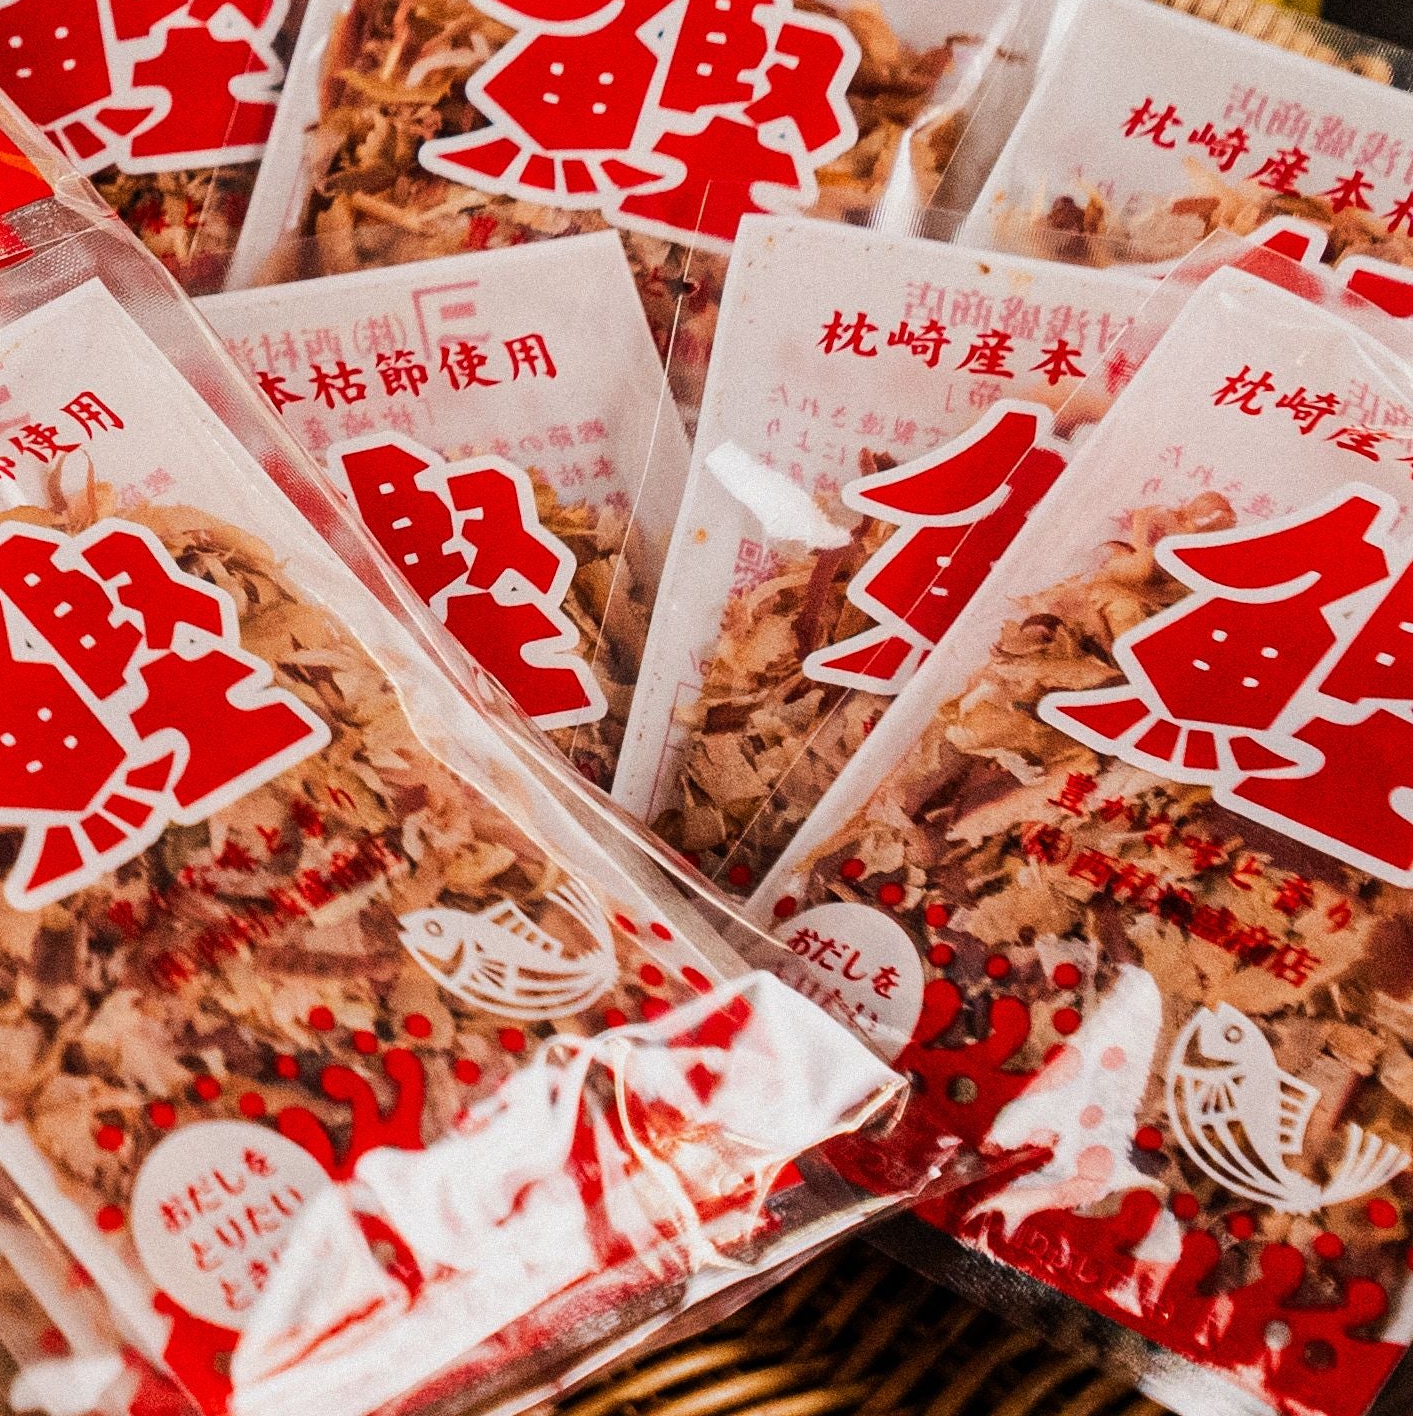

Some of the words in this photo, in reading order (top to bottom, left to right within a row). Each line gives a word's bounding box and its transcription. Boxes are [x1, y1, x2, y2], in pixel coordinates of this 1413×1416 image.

[817, 309, 1139, 396] 枕崎産本
[1211, 365, 1413, 480] 枕崎産
[787, 927, 901, 1000] おだしを
